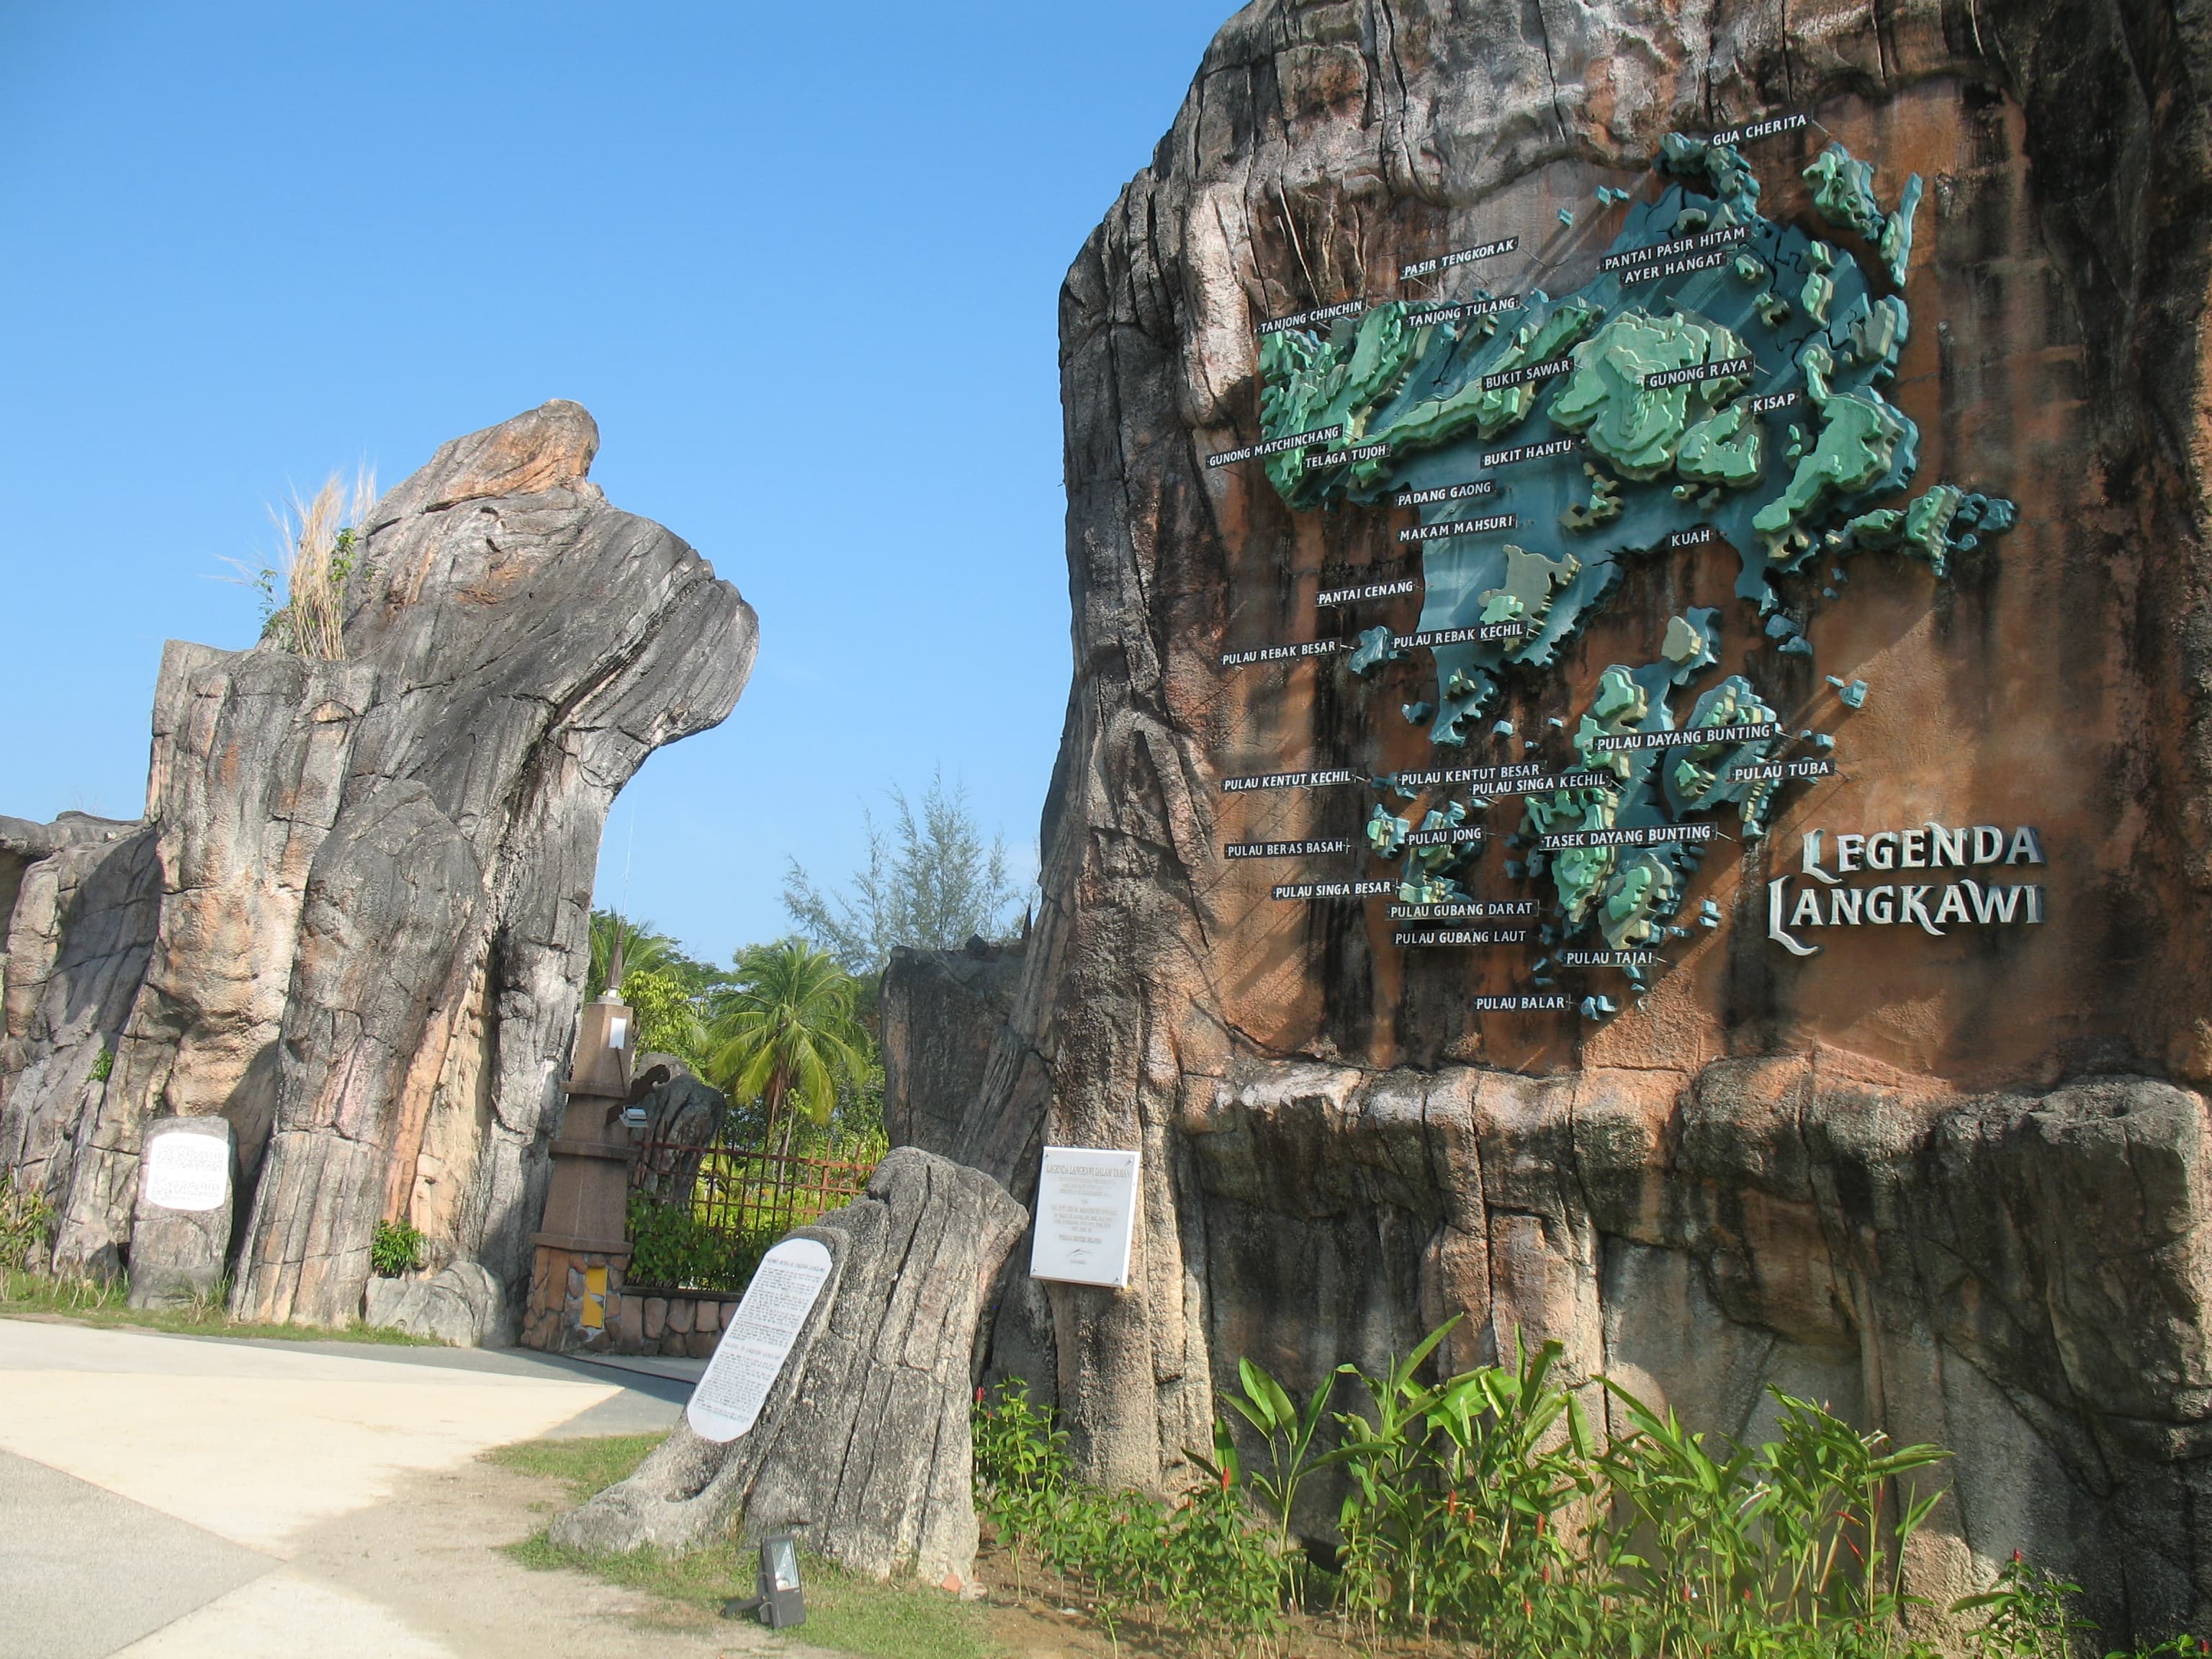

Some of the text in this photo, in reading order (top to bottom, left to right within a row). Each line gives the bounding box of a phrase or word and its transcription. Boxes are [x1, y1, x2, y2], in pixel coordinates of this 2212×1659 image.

[1713, 114, 1807, 146] GUA CHERITA
[1404, 240, 1514, 276] PASIR TENGKORAK
[1605, 227, 1745, 269] PANTAI PASIR HITAM
[1624, 253, 1722, 283] AYER HANGAT
[1261, 301, 1362, 332] TANJONG CHINCHIN
[1409, 298, 1515, 326] TANJONG TULANG
[1485, 360, 1570, 388] BUKIT SAWAR
[1650, 360, 1747, 387] GUNONG RAYA
[1753, 392, 1795, 412] KISAP
[1210, 427, 1339, 466] GUNONG MATCHINCHANG
[1305, 445, 1386, 468] TELAGA TUJOH
[1484, 441, 1572, 466] BUKIT HANTU
[1398, 482, 1491, 505] PADANG GAONG
[1400, 516, 1513, 541] MAKAM MAHSURI
[1672, 529, 1709, 547] KUAH
[1318, 581, 1413, 604] PANTAI CENANG
[1393, 624, 1523, 647] PULAU REBAK KECHIL
[1223, 641, 1335, 665] PULAU REBAK BESAR
[1597, 724, 1771, 751] PULAU DAYANG BUNTING
[1225, 770, 1350, 791] PULAU KENTUT KECHIL
[1401, 764, 1539, 785] PULAU KENTUT BESAR
[1735, 762, 1828, 780] PULAU TUBA
[1473, 773, 1606, 795] PULAU SINGA KECHIL
[1408, 828, 1481, 845] PULAU JONG
[1545, 824, 1710, 847] TASEK DAYANG BUNTING
[1228, 841, 1343, 856] PULAU BERAS BASAH
[1802, 822, 2044, 885] LEGENDA
[1276, 882, 1390, 898] PULAU SINGA BESAR
[1390, 903, 1532, 918] PULAU GUBANG DARAT
[1768, 875, 2044, 956] LANGKAWI
[1395, 931, 1526, 944] PULAU GUBANG LAUT
[1567, 950, 1653, 966] PULAU TAJAI
[1476, 996, 1564, 1010] PULAU BALAR
